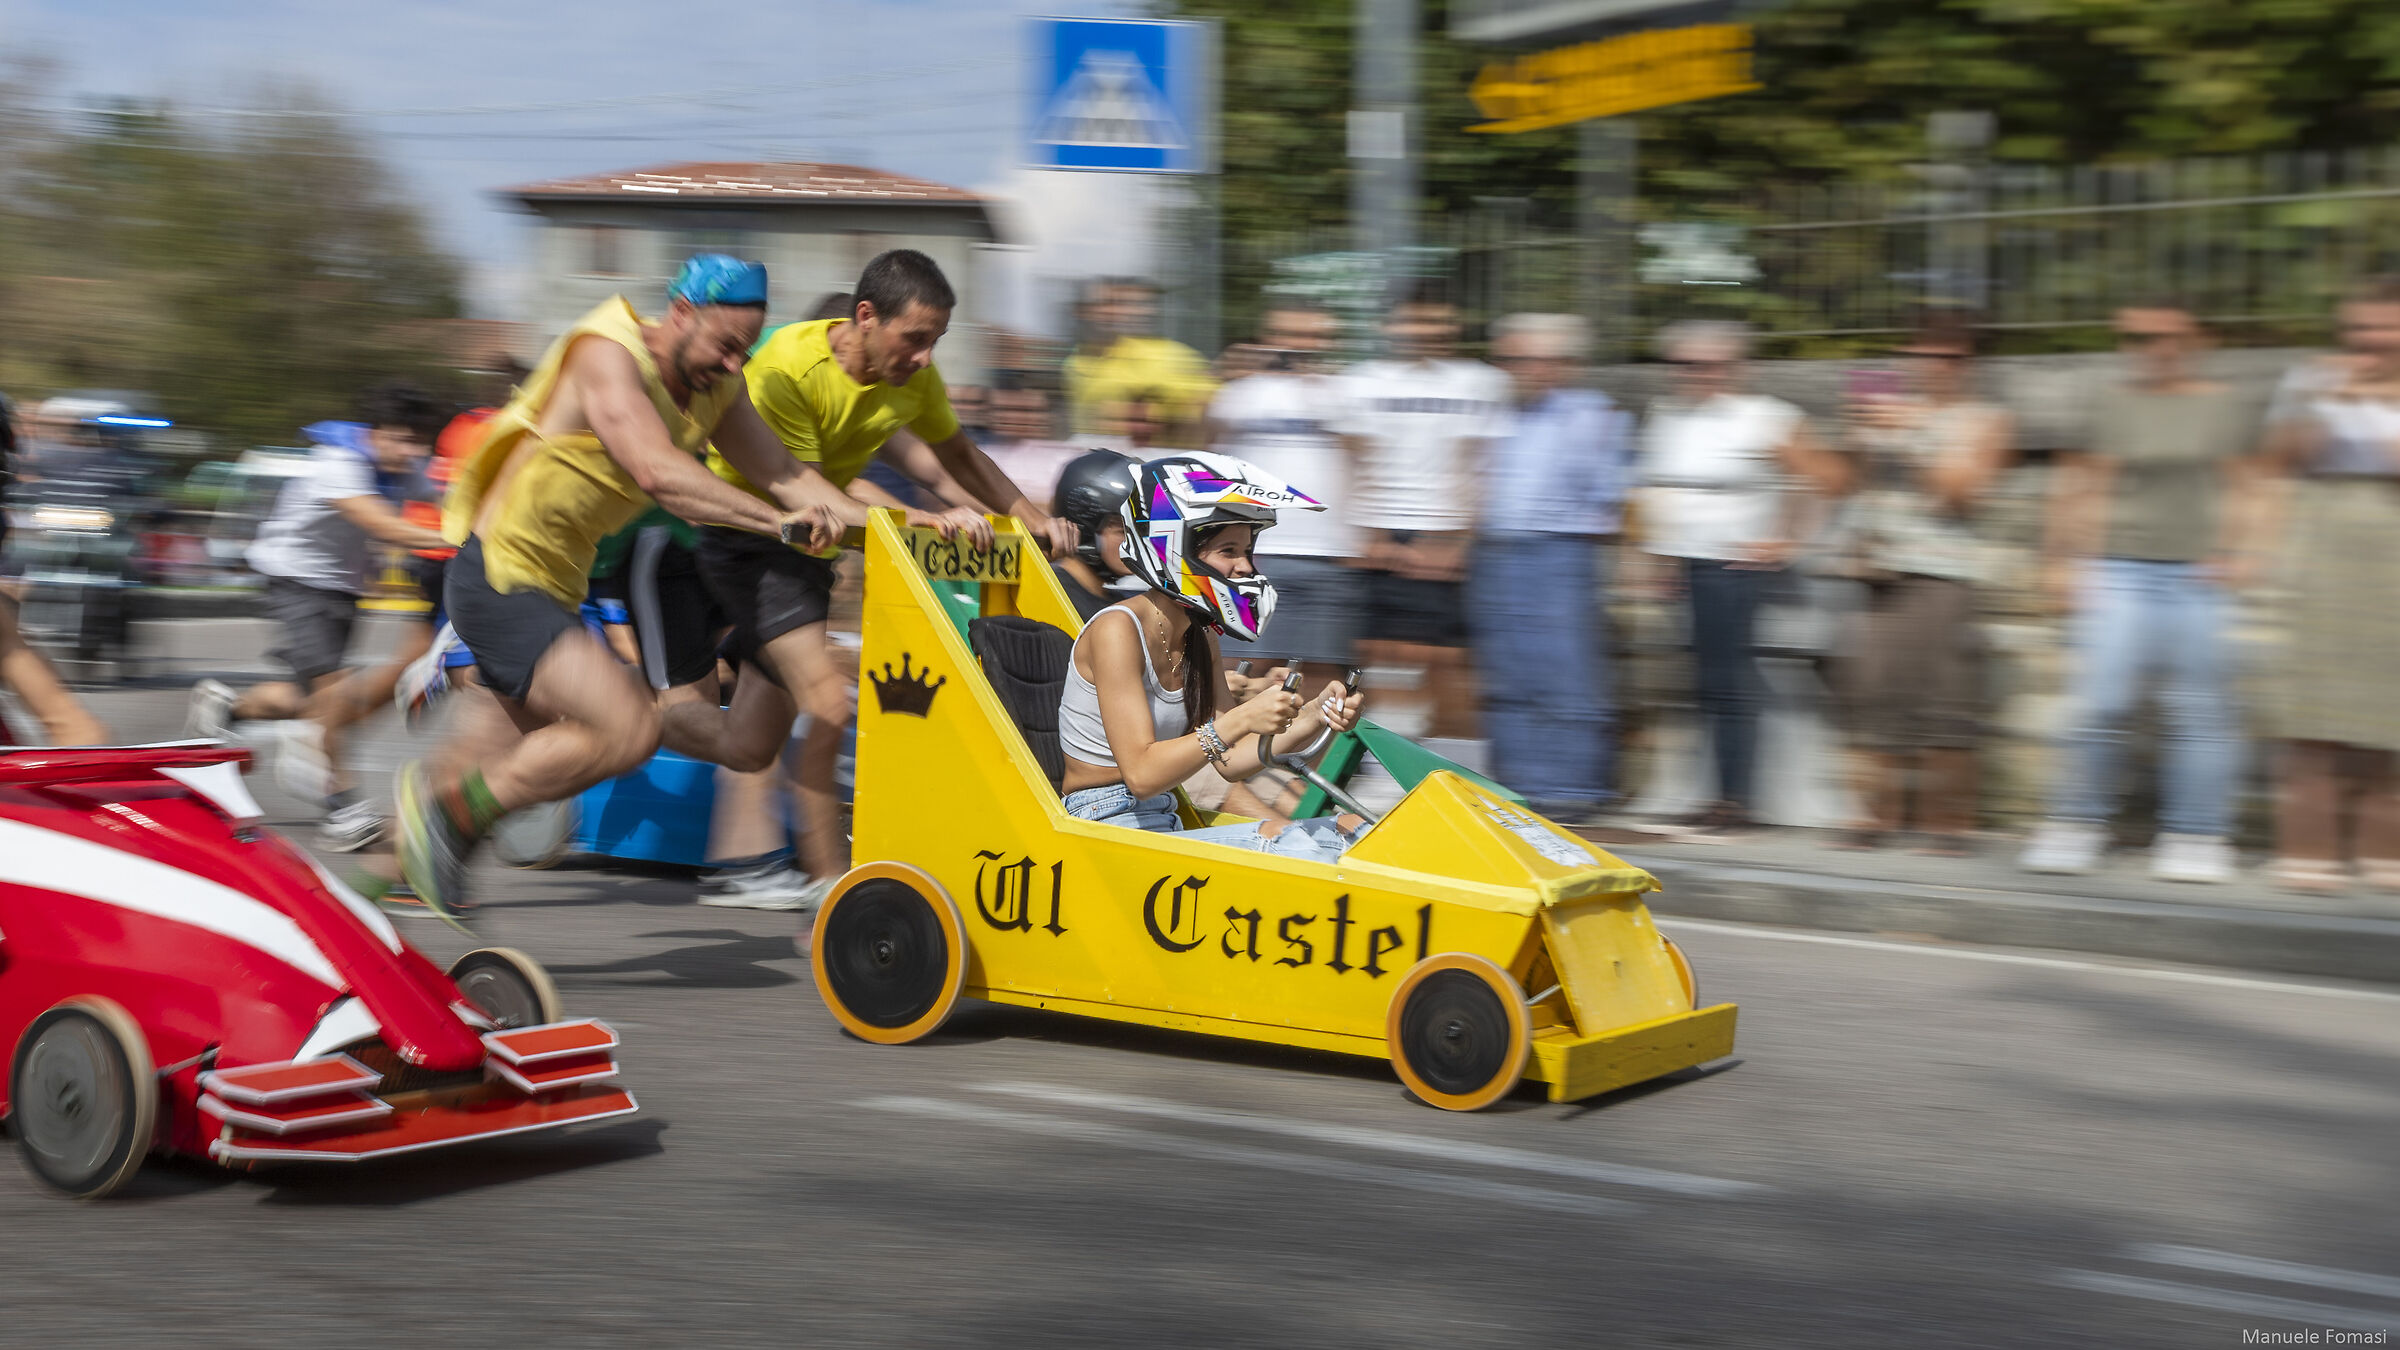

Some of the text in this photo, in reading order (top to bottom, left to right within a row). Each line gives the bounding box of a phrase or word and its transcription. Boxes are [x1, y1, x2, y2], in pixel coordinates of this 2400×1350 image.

[1232, 485, 1295, 503] AIROH
[924, 540, 1021, 579] Castel
[1220, 592, 1236, 623] AIROH
[973, 849, 1432, 979] Ul Castel
